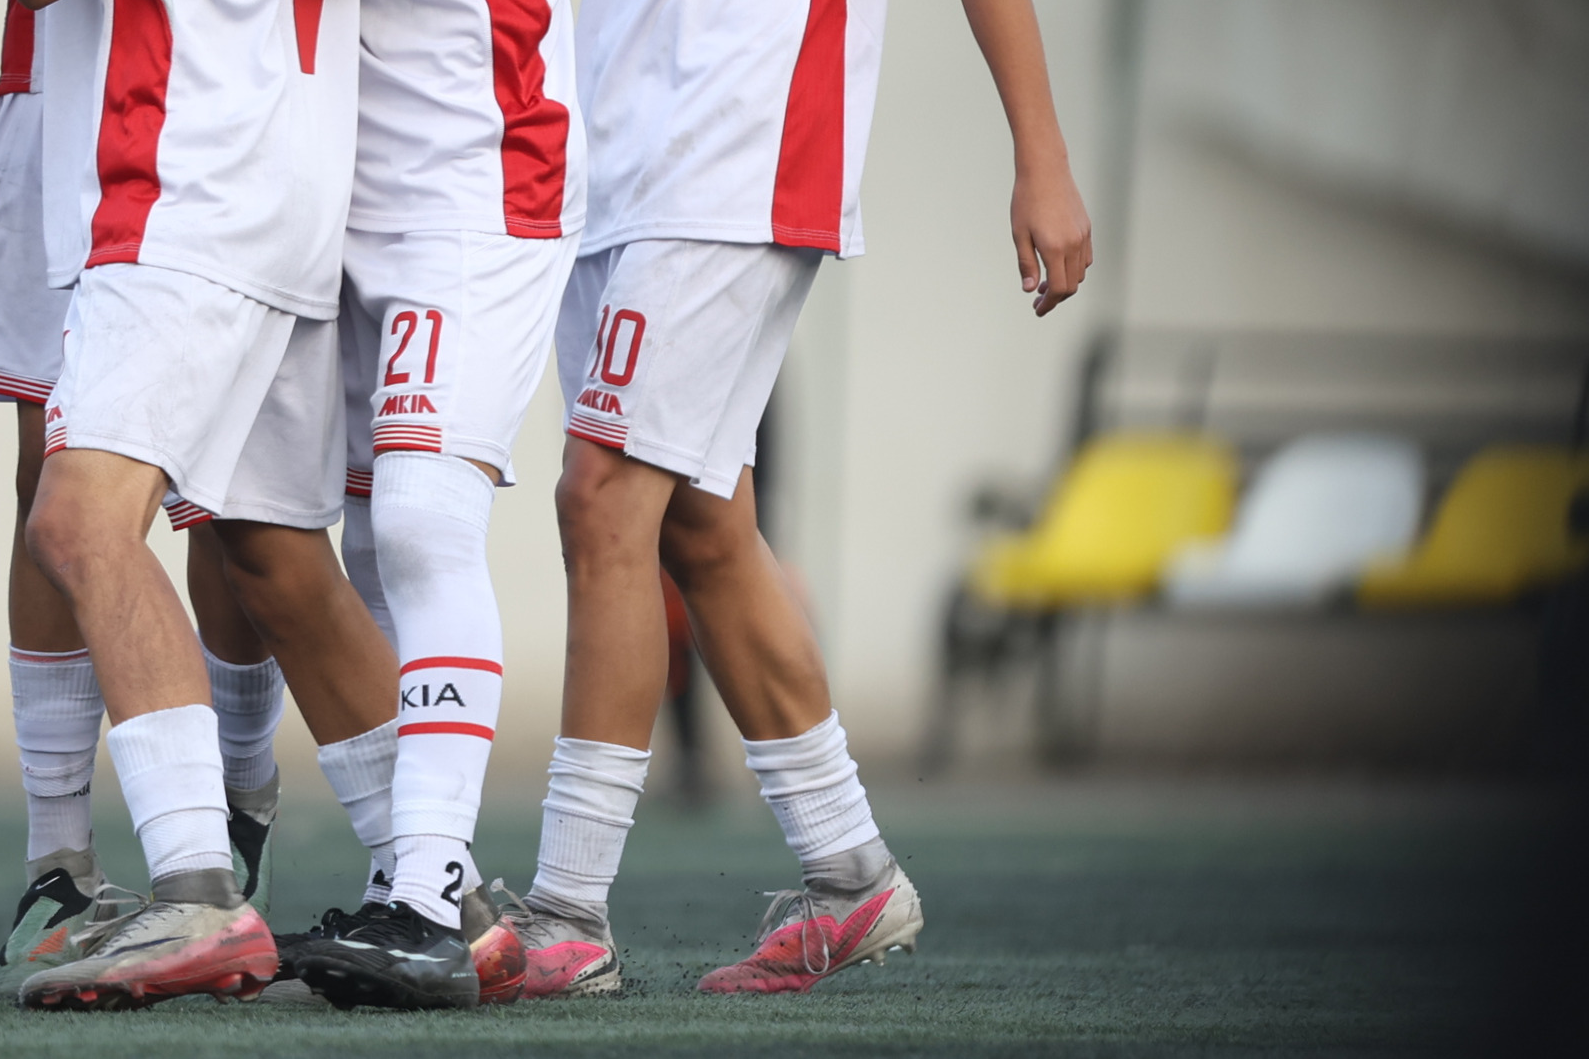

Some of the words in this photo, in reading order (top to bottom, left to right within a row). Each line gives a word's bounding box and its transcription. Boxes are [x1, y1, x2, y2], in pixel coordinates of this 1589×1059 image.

[383, 309, 444, 388] 21
[589, 303, 647, 387] 10
[377, 394, 439, 418] MKIA
[576, 387, 624, 416] MKIA
[401, 682, 467, 712] KIA
[440, 860, 464, 910] 2
